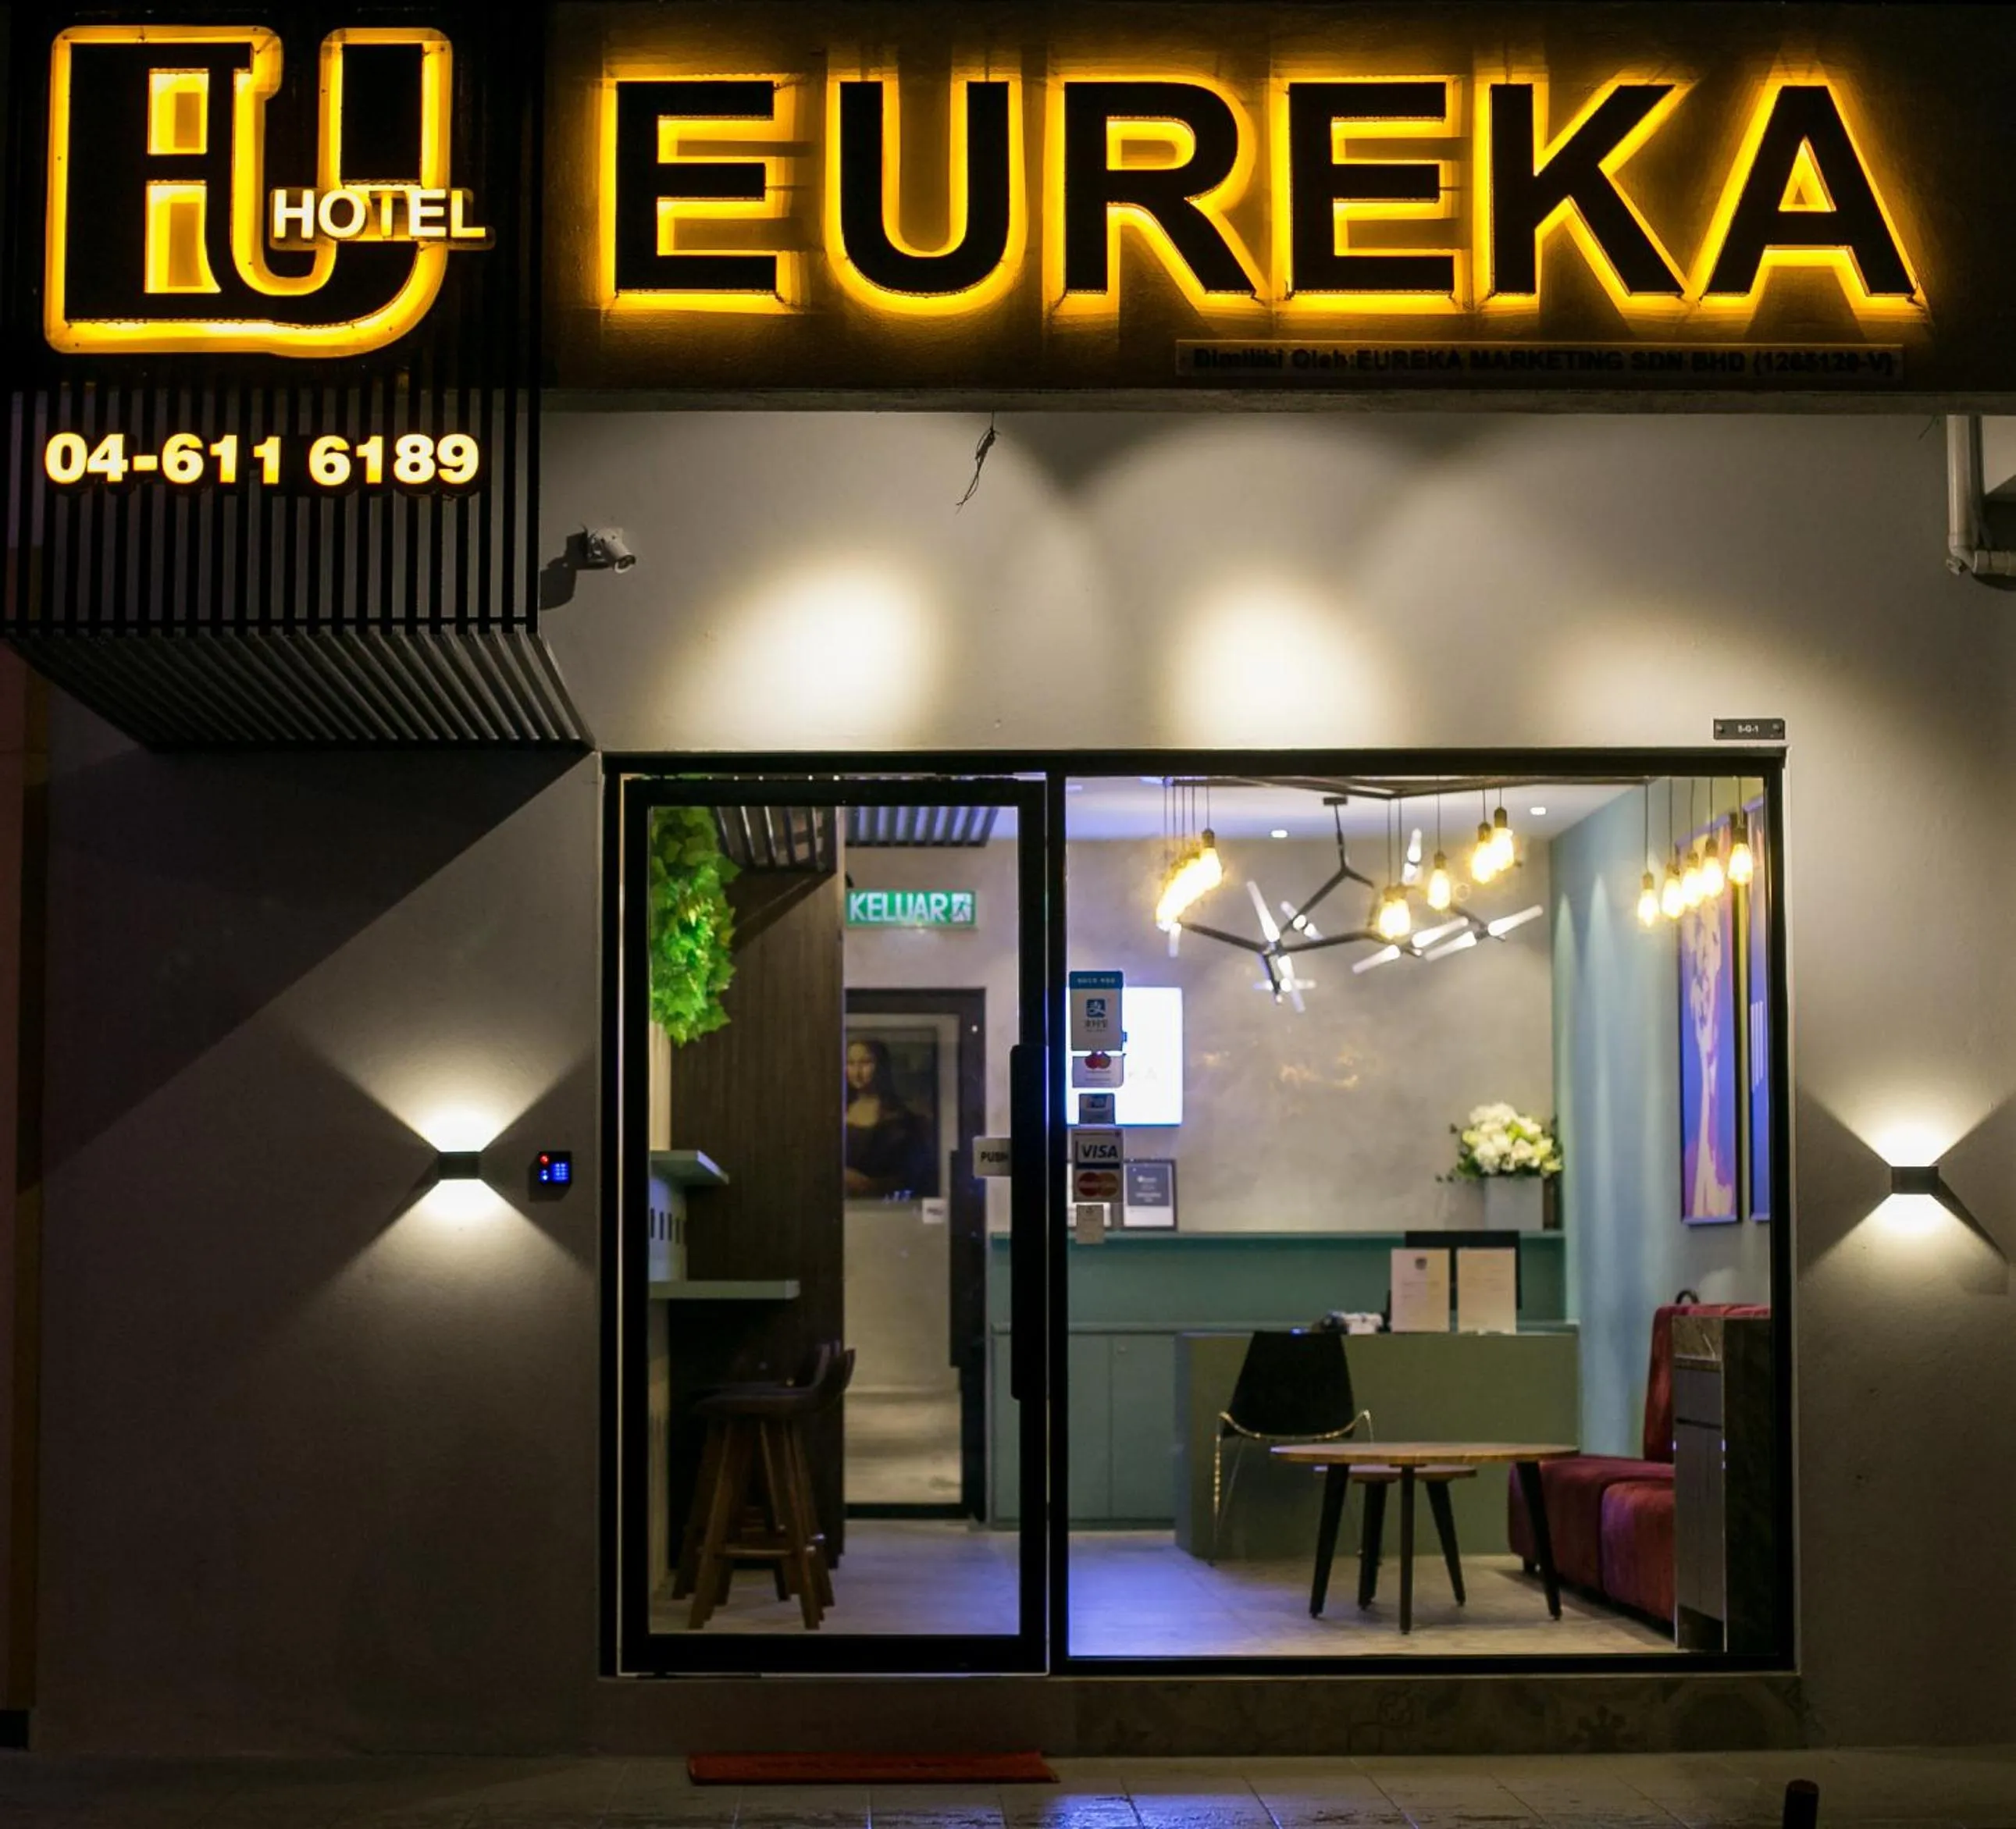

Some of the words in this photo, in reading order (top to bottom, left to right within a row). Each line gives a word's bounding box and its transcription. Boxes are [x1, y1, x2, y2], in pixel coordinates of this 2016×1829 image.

[612, 79, 1921, 297] EUREKA
[273, 189, 486, 239] HOTEL
[45, 433, 280, 484] 04-611
[309, 434, 479, 486] 6189
[849, 892, 948, 923] KELUAR
[1081, 1144, 1118, 1158] VISA
